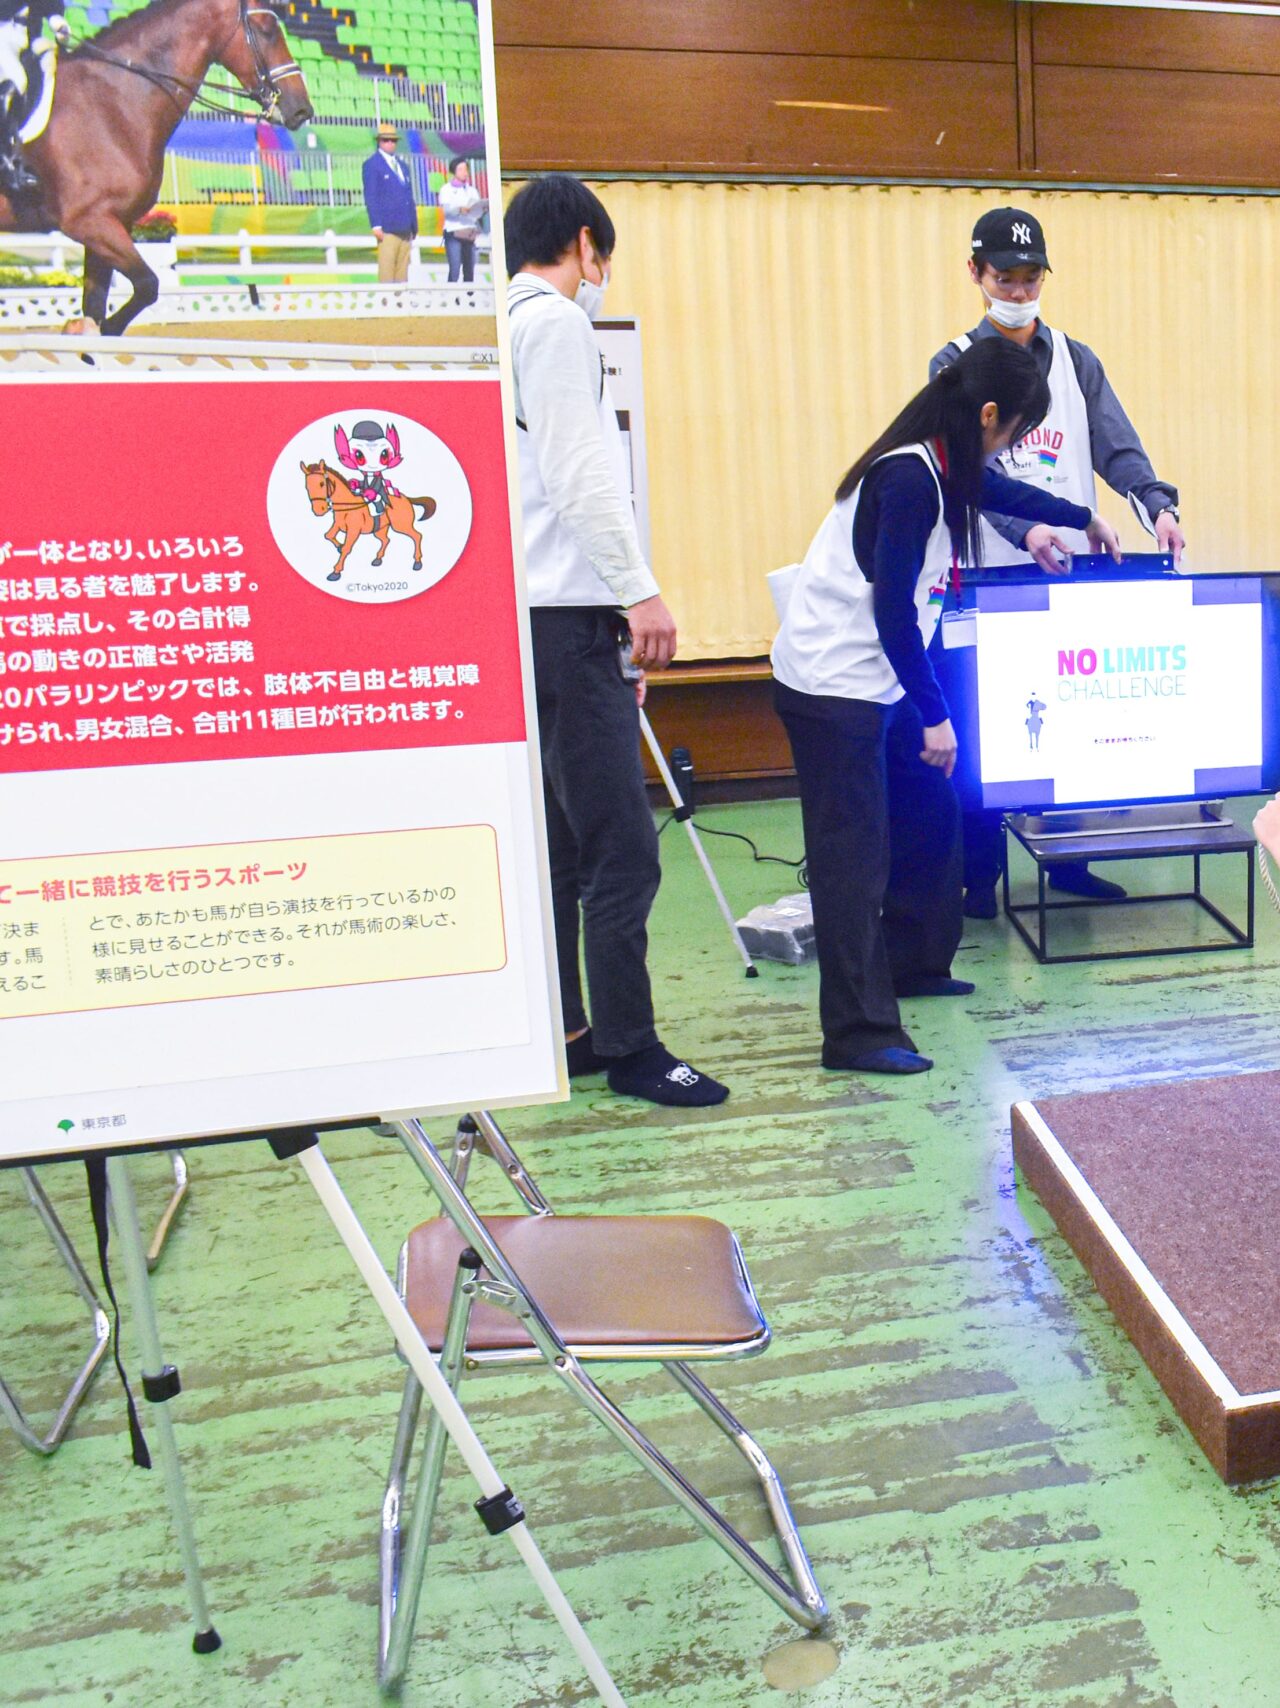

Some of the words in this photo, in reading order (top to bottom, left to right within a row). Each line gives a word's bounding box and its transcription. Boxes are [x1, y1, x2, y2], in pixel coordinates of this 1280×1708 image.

[0, 605, 250, 639] で採点し、その合計得
[0, 640, 254, 675] の動きの正確さや活発
[1057, 648, 1097, 676] NO
[1103, 645, 1187, 673] LIMITS
[0, 664, 480, 709] 0パラリンピックでは、肢体不自由と視覚障
[1057, 674, 1187, 702] CHALLENGE
[95, 952, 296, 984] 素晴らしさのひとつです。
[82, 1114, 127, 1130] 東京都
